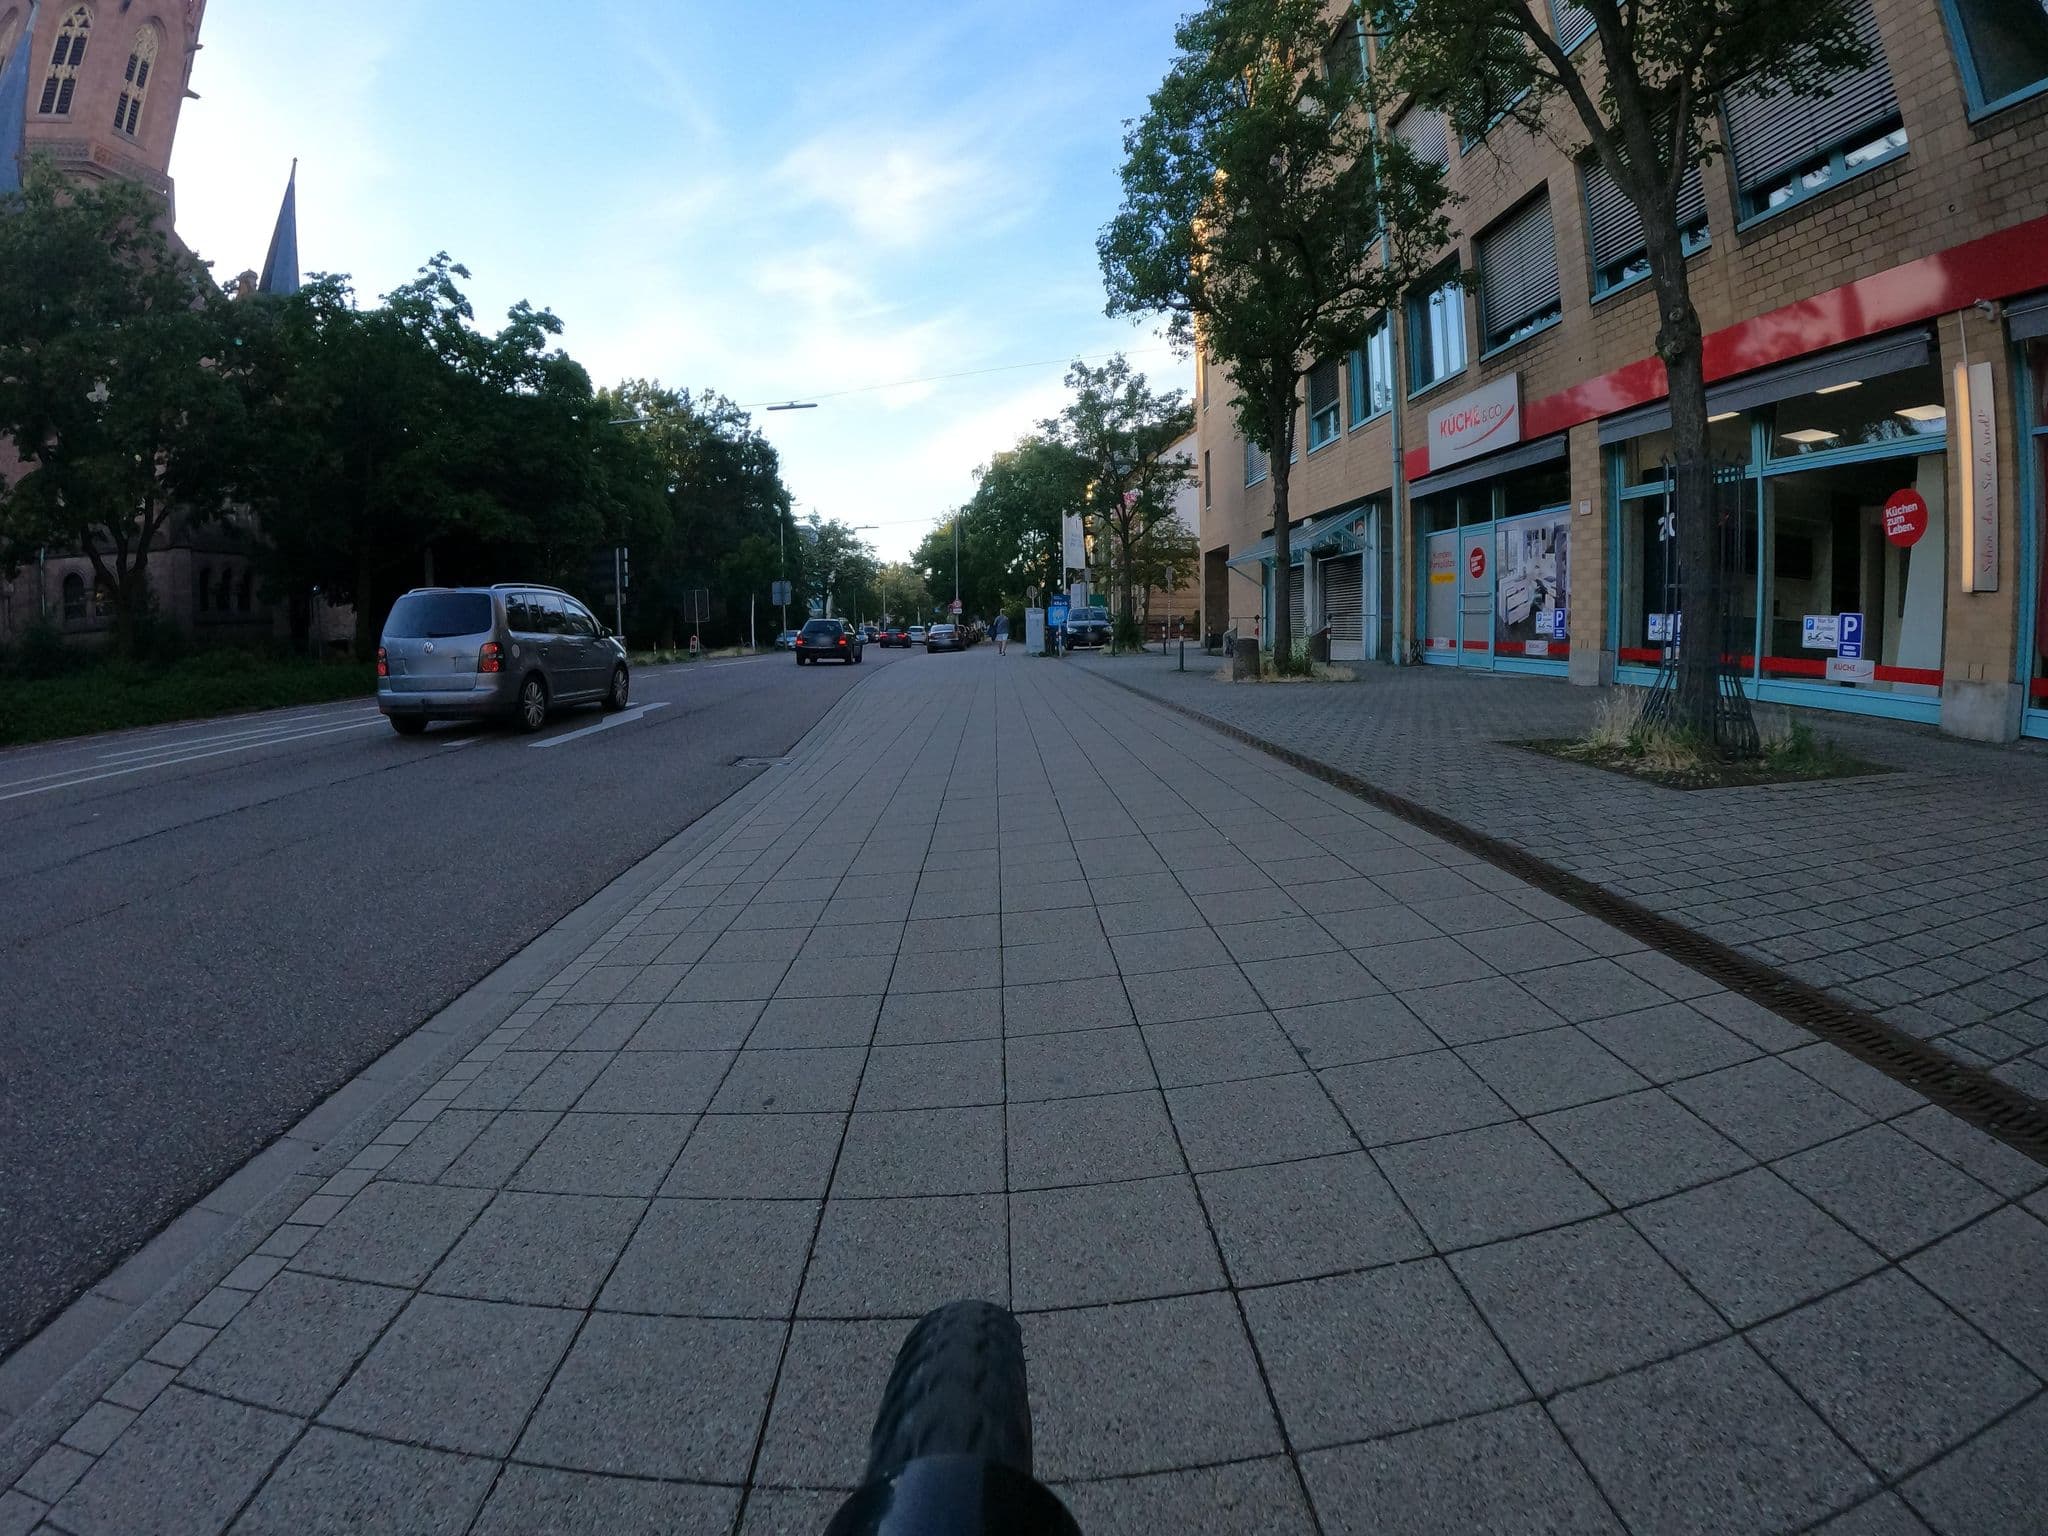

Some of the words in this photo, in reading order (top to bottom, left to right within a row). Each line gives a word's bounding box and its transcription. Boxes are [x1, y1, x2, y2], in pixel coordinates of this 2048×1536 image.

[1885, 503, 1918, 518] Küchen
[1886, 515, 1905, 527] zum
[1887, 523, 1915, 536] Leben.
[1555, 611, 1563, 626] P
[1844, 616, 1858, 641] P
